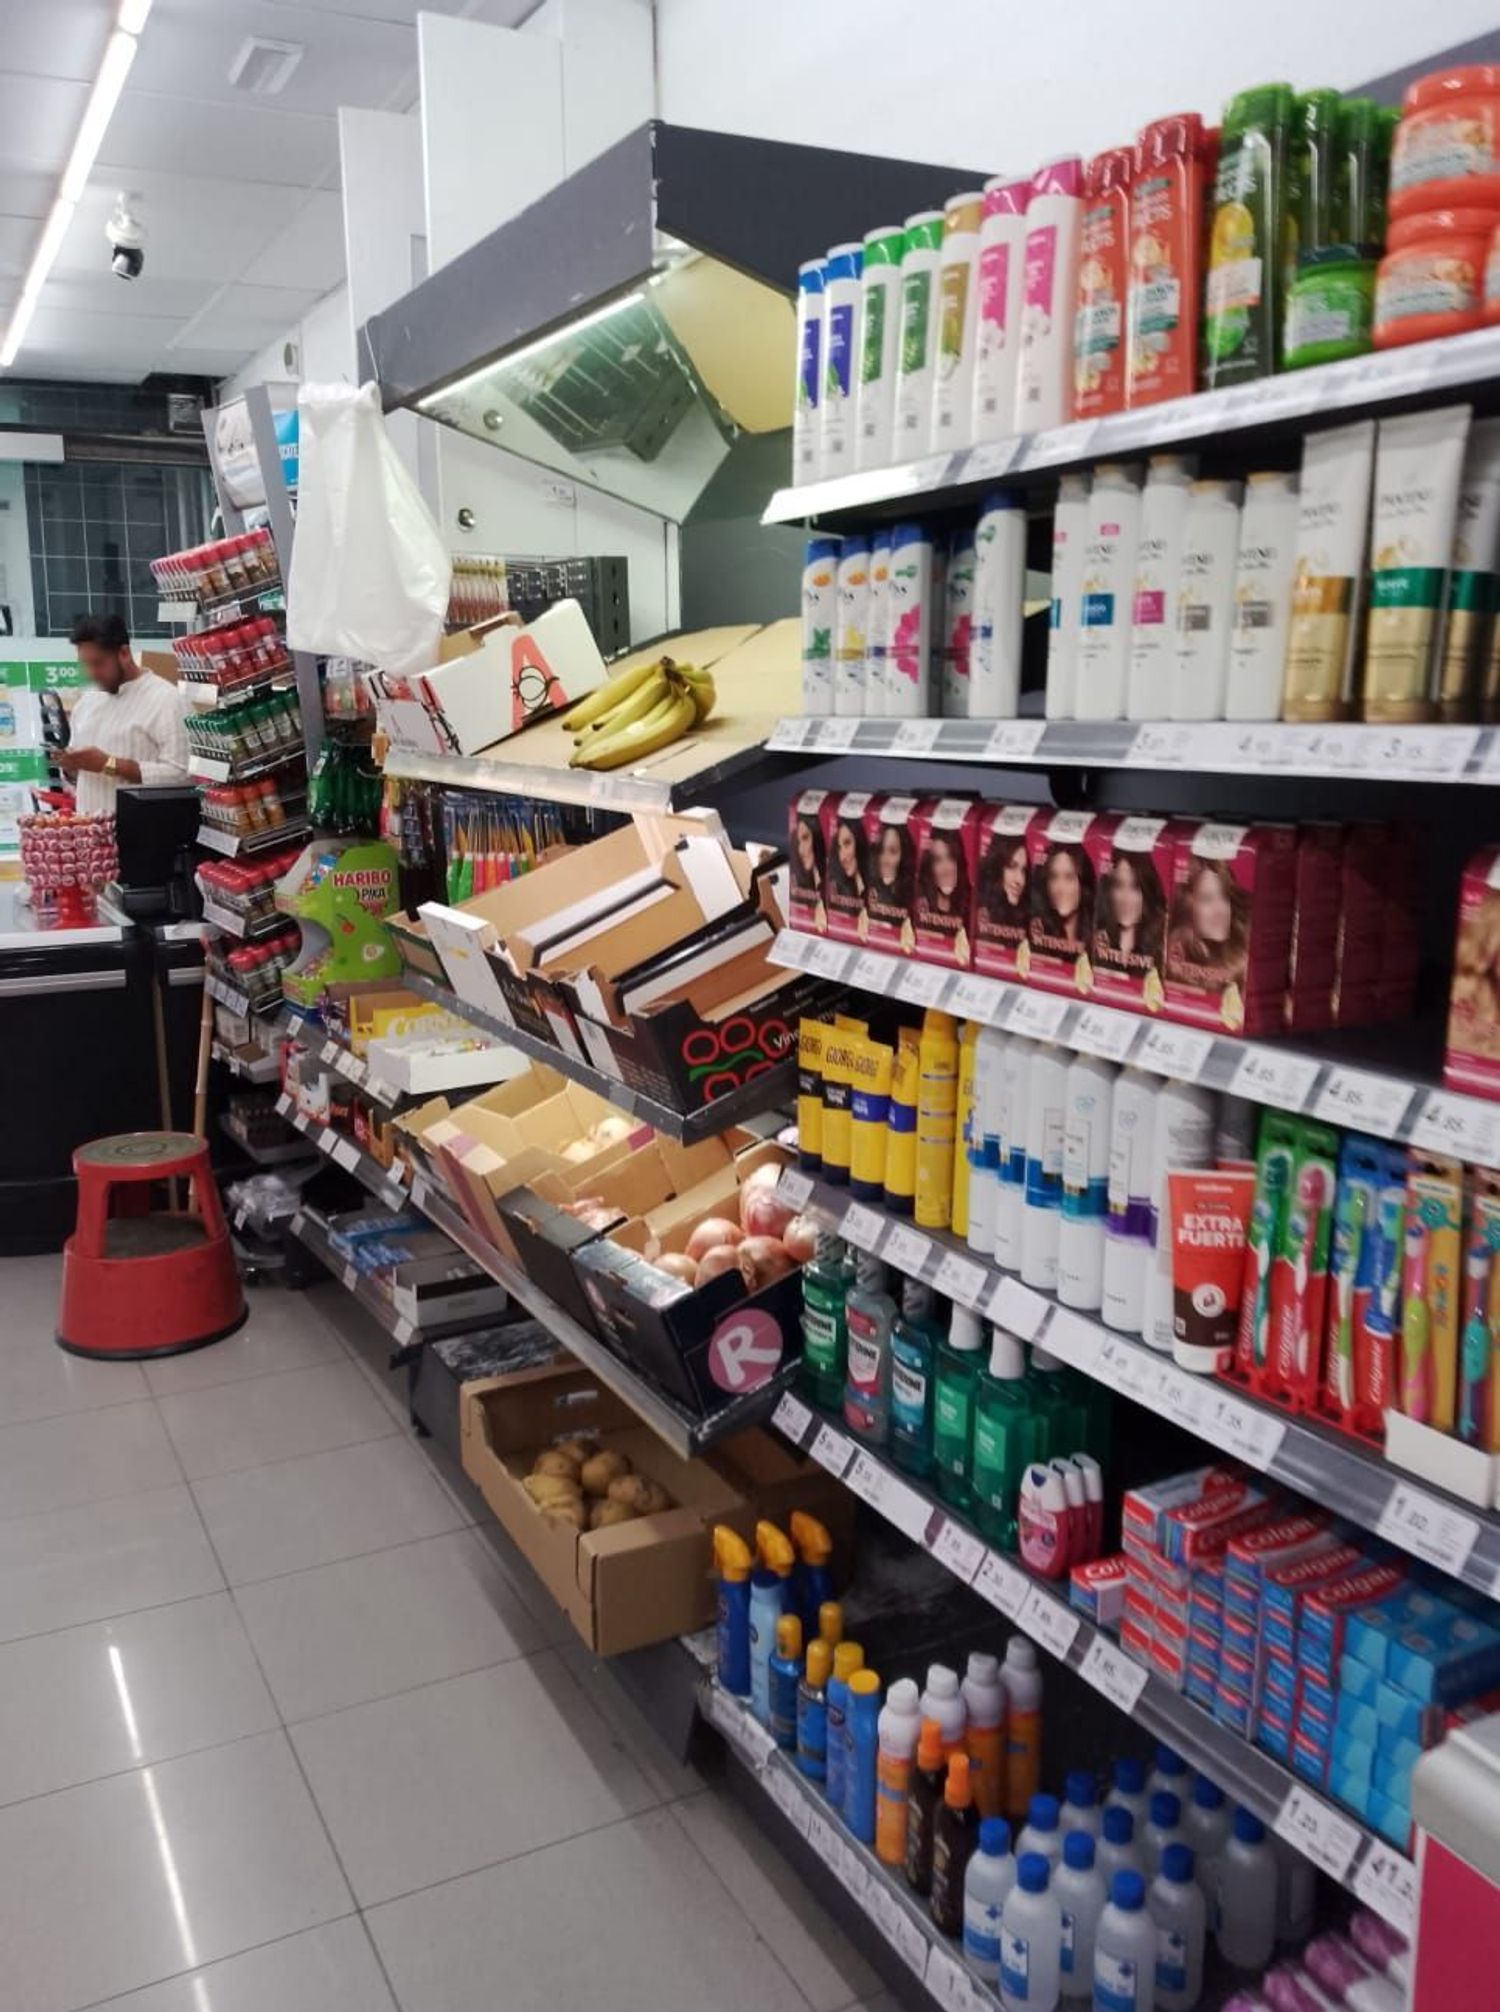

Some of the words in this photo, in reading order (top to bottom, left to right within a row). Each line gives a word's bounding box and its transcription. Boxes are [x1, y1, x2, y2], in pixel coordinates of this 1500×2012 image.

[333, 870, 392, 887] HARIBO
[1182, 1213, 1244, 1233] EXTRA
[715, 1325, 780, 1388] R
[1278, 1303, 1295, 1380] Colgate
[1368, 1339, 1384, 1405] Colgate
[1275, 1547, 1362, 1584] Colgate
